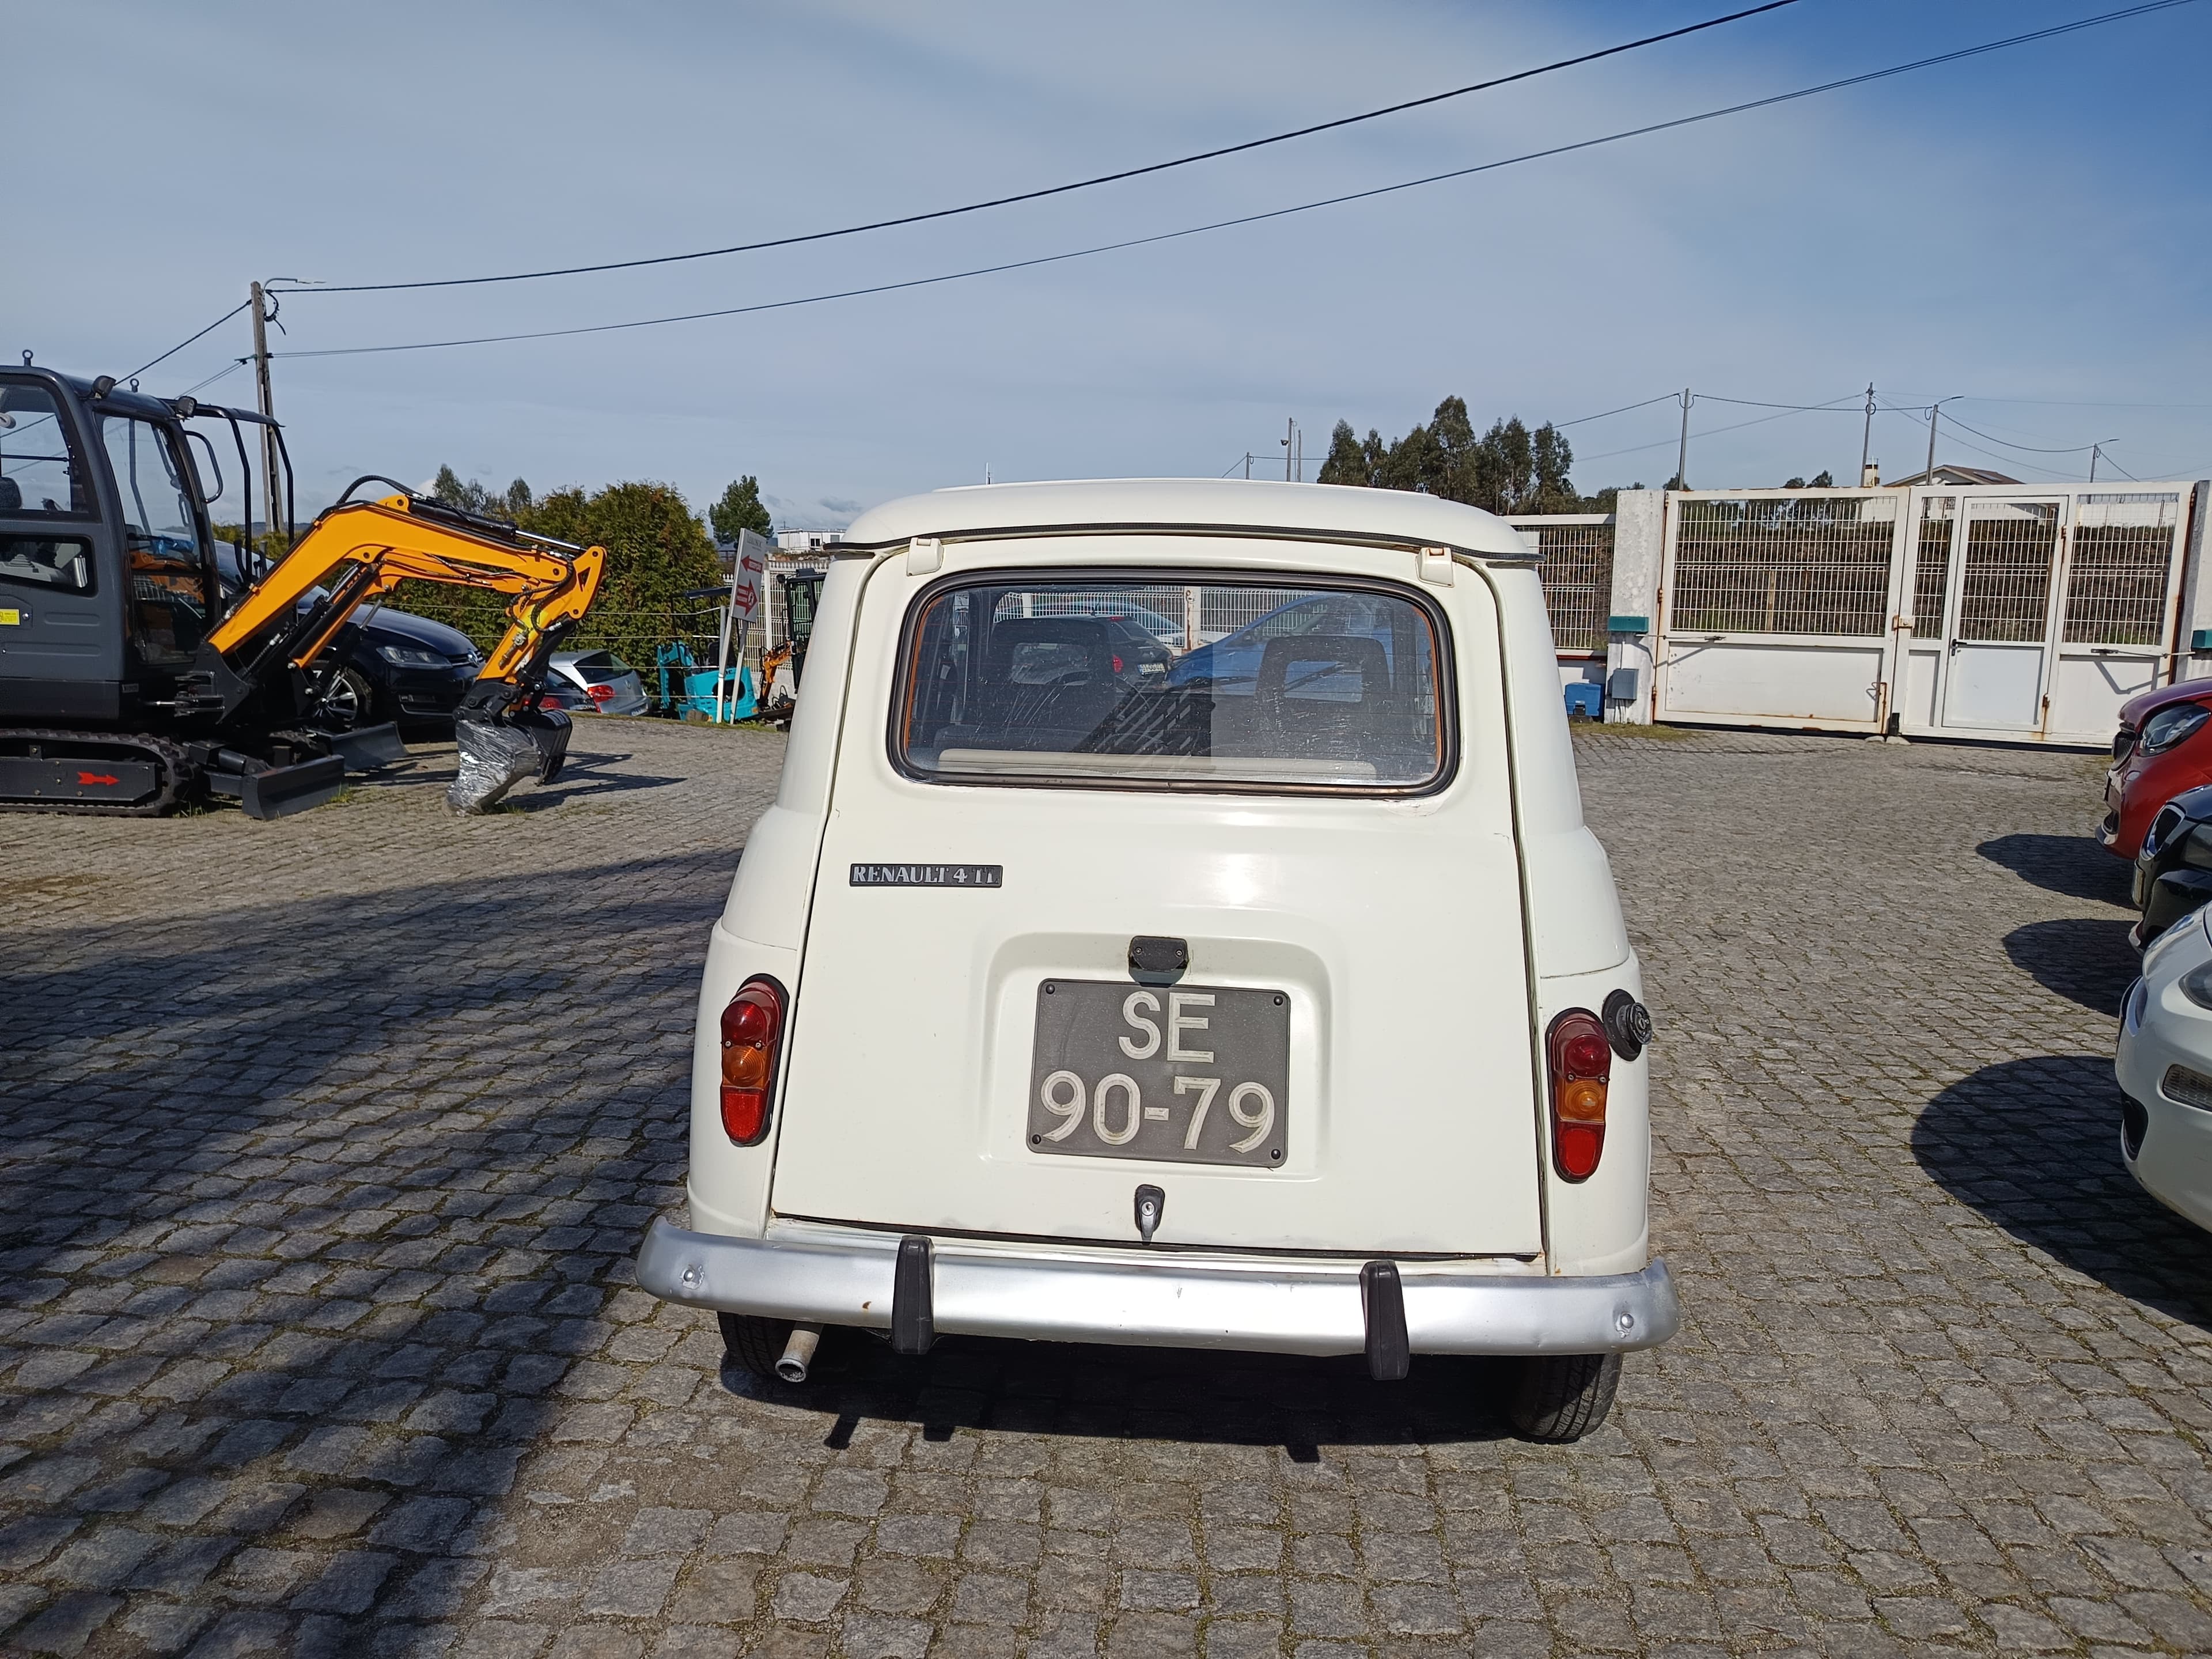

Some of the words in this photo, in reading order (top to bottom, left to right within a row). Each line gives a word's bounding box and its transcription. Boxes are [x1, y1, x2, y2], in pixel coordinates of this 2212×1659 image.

[852, 866, 949, 884] RENAULT
[953, 868, 968, 884] 4
[1118, 991, 1216, 1063] SE
[1040, 1070, 1275, 1154] 90-79
